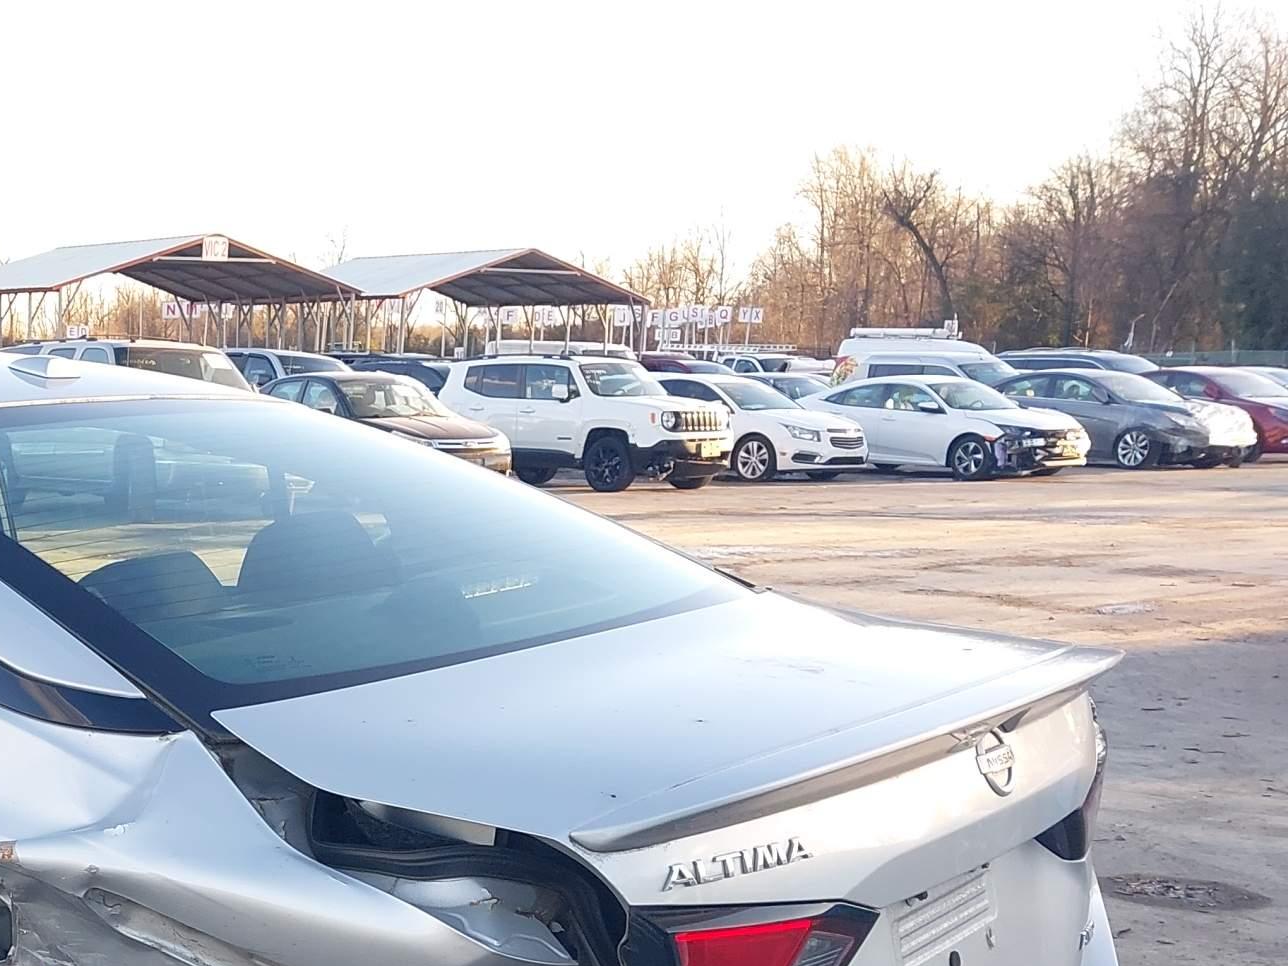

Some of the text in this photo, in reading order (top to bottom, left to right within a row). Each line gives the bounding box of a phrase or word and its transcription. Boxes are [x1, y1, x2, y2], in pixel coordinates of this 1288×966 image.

[204, 239, 228, 257] VIC 2
[166, 304, 176, 315] N
[691, 307, 698, 318] S
[719, 309, 728, 320] Q
[742, 309, 747, 320] Y
[753, 309, 760, 320] X
[506, 310, 513, 322] F
[652, 314, 659, 325] F
[669, 312, 679, 322] G
[69, 327, 75, 336] E
[661, 836, 814, 892] ALTIMA
